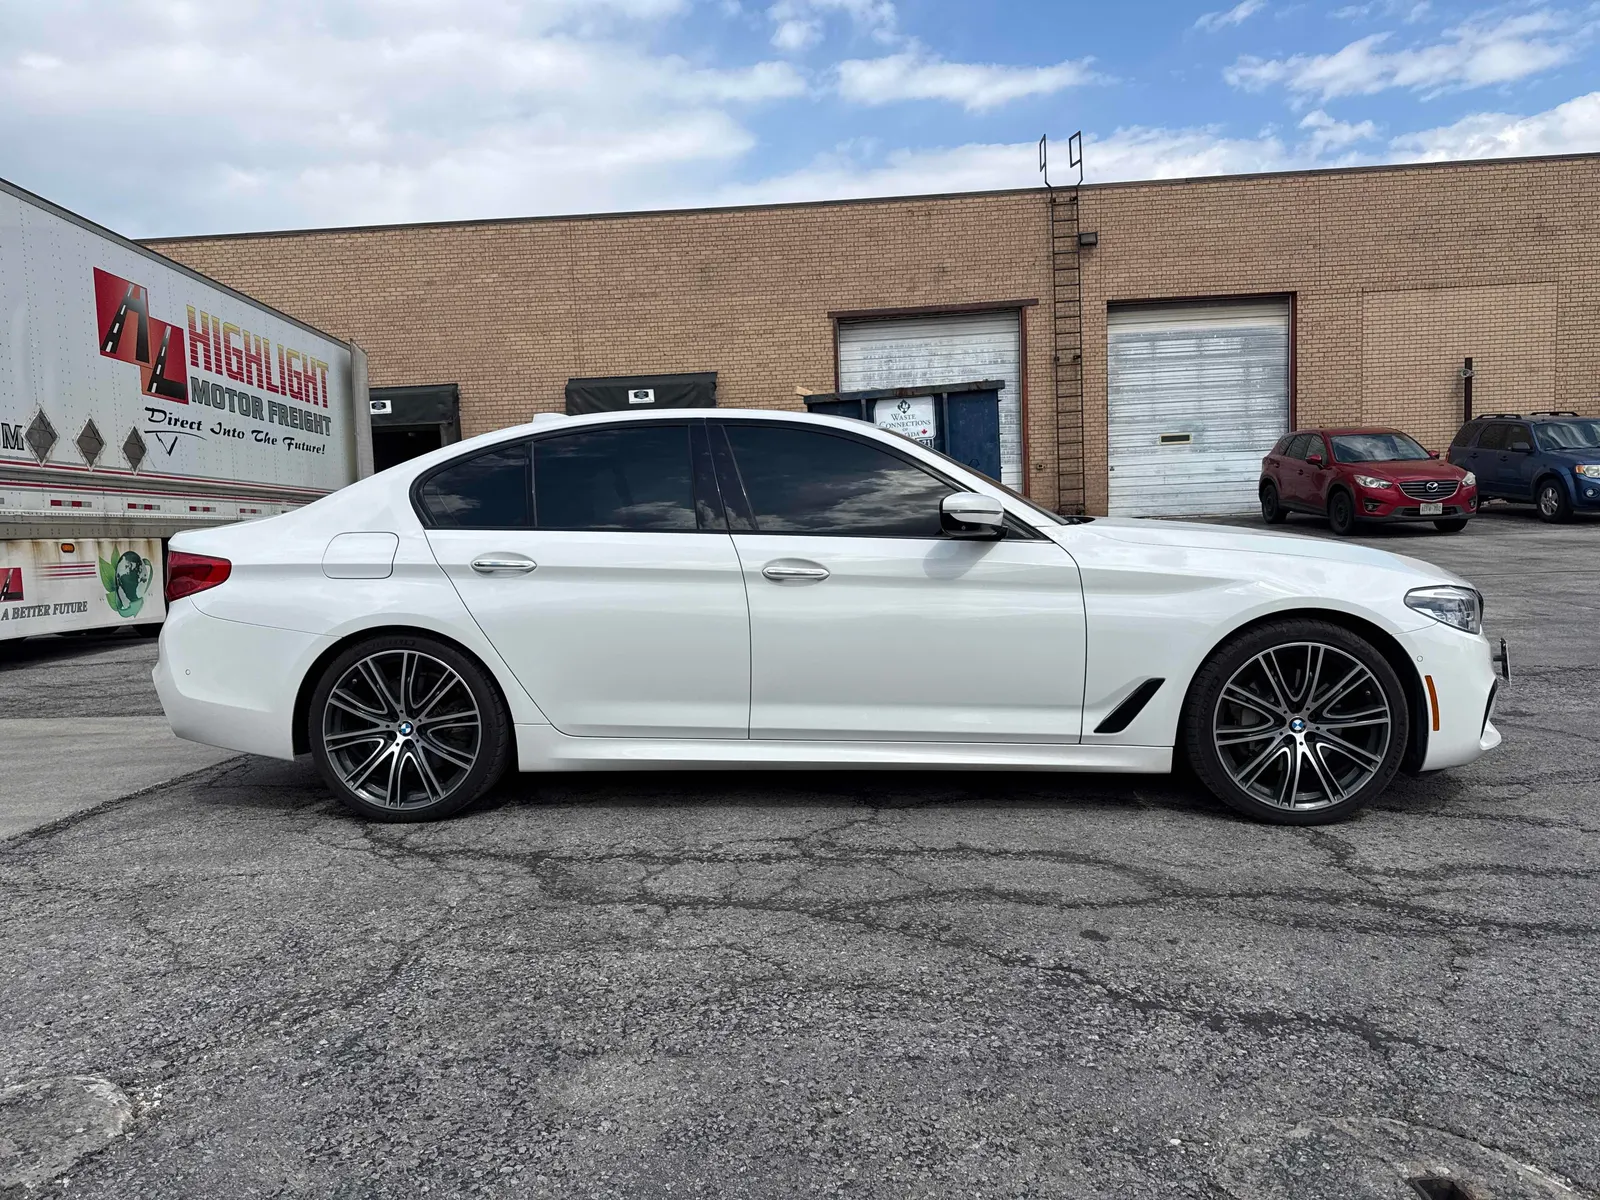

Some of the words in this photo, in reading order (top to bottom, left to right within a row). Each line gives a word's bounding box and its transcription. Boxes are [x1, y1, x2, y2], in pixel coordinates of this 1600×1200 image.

[186, 304, 329, 409] HIGHLIGHT
[145, 406, 203, 431] Direct
[210, 422, 245, 439] Into
[251, 430, 278, 446] The
[282, 436, 326, 455] Future!
[190, 376, 265, 421] MOTOR
[267, 400, 332, 436] FREIGHT
[891, 413, 917, 421] WASTE
[1, 608, 10, 621] A
[11, 604, 51, 620] BETTER
[52, 601, 88, 616] FUTURE
